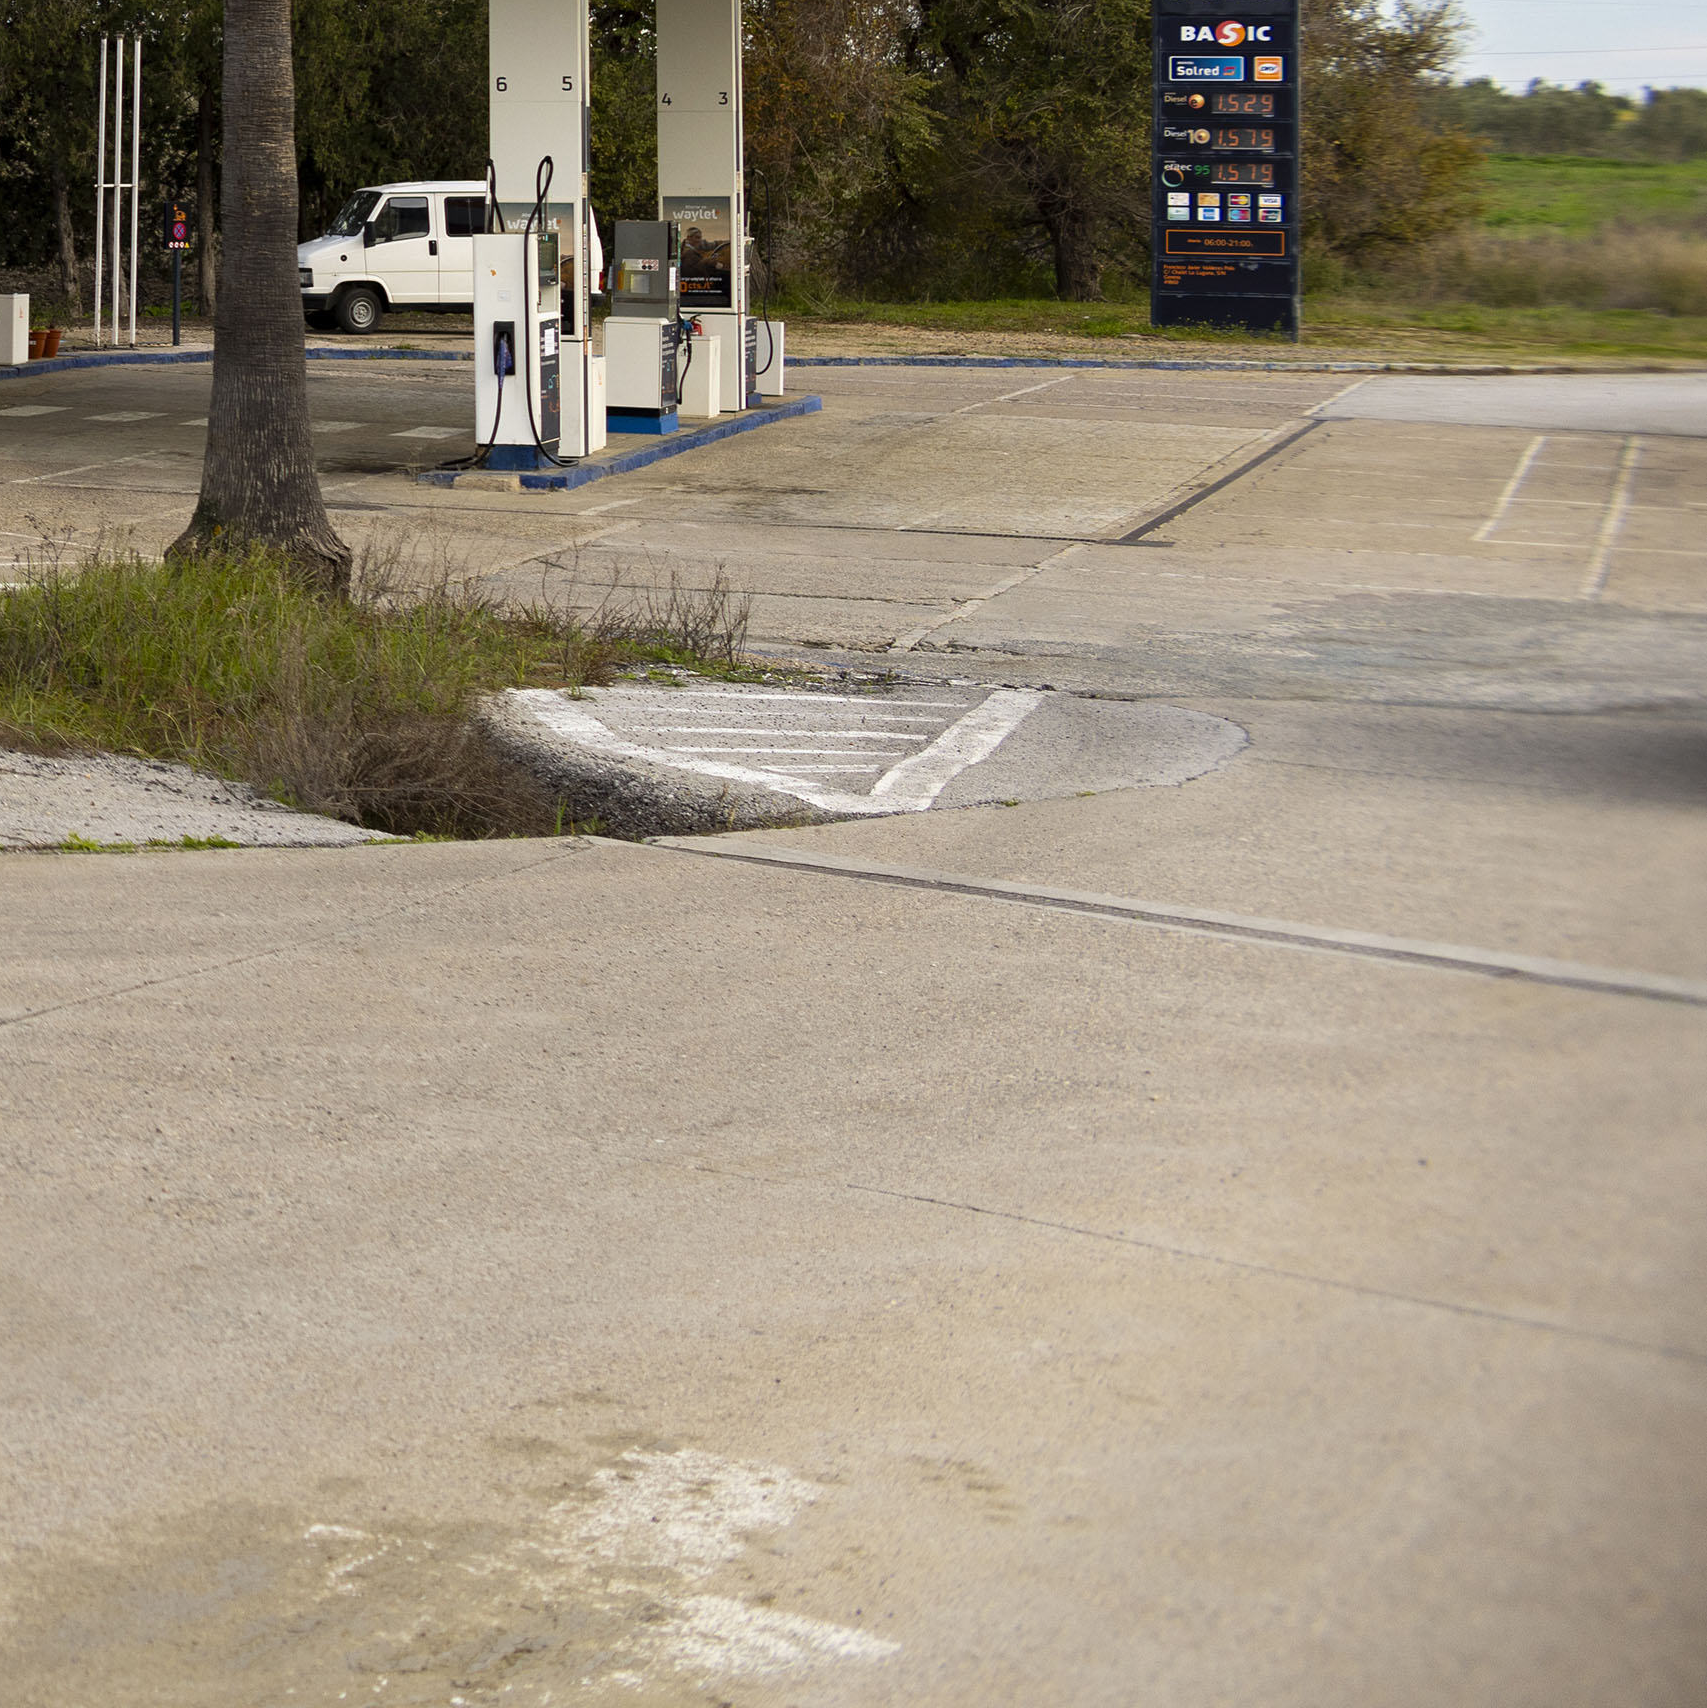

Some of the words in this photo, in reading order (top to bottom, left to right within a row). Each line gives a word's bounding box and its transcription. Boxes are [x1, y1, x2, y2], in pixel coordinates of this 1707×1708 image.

[1180, 22, 1272, 44] BASIC
[1176, 66, 1220, 76] Solred
[496, 77, 507, 92] 6
[562, 76, 573, 91] 5
[661, 93, 672, 106] 4
[718, 92, 728, 105] 3
[1164, 95, 1187, 103] Diesel
[1218, 94, 1273, 112] 1.529
[1164, 129, 1187, 138] Diesel
[1218, 129, 1273, 147] 1.579
[1194, 165, 1211, 175] 95
[1218, 164, 1273, 181] 1.579
[672, 209, 718, 222] waylet
[506, 218, 559, 232] wayet
